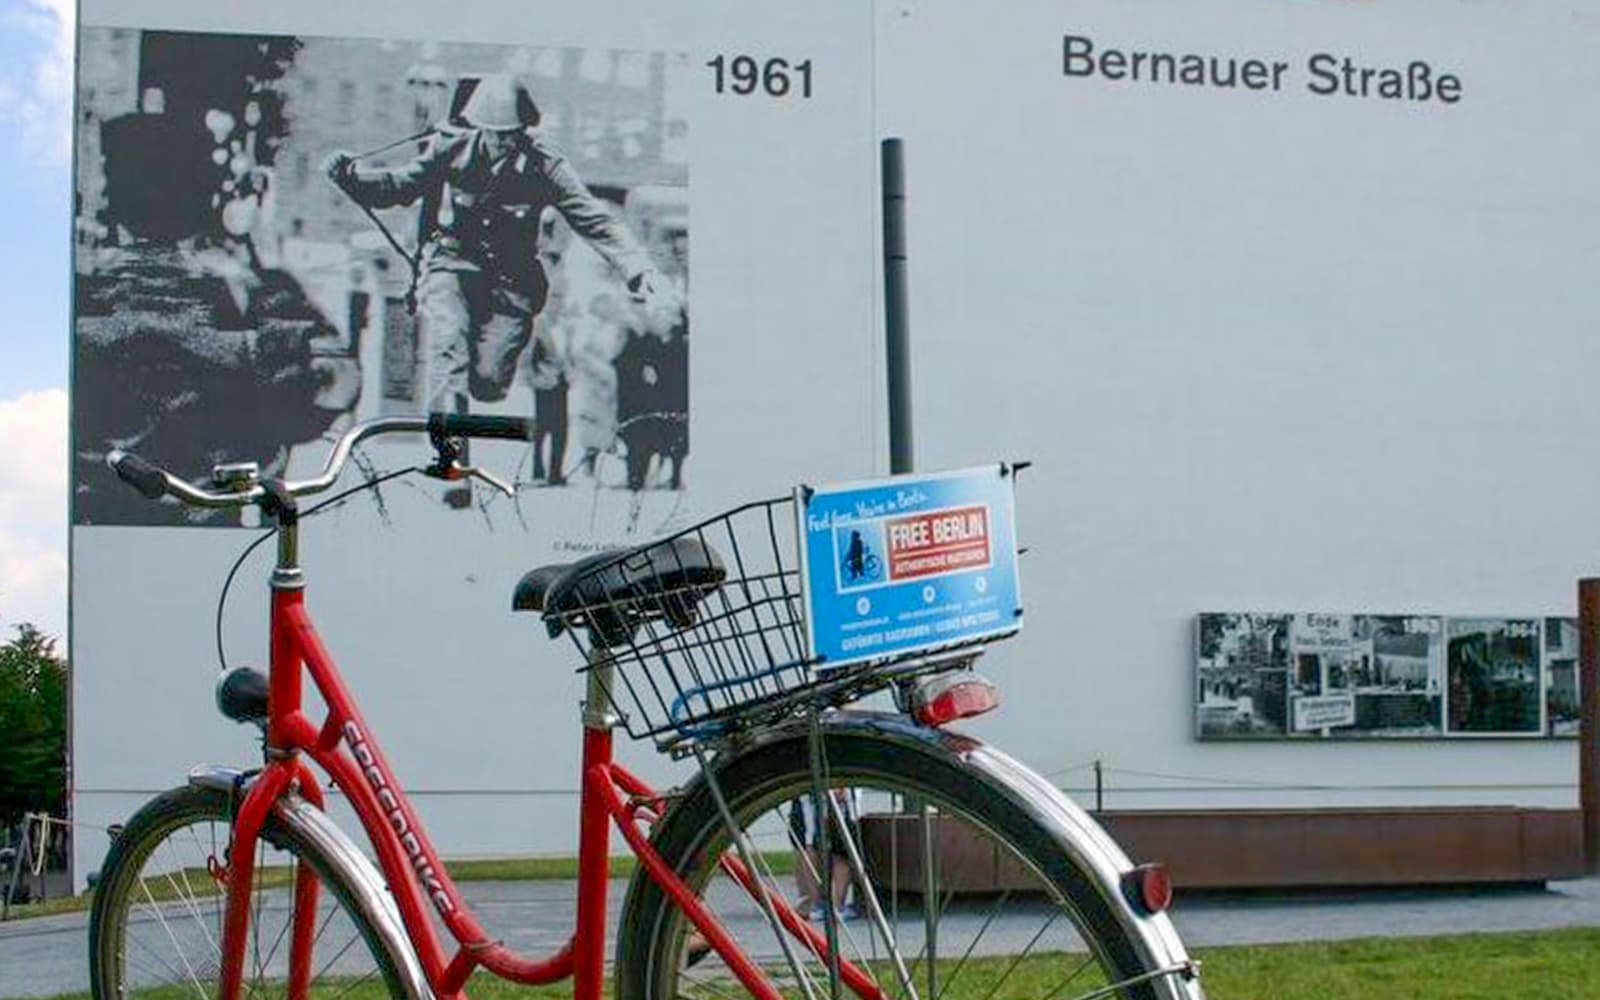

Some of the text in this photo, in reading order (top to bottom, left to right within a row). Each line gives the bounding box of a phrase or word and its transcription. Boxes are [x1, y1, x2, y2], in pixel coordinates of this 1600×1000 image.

[705, 53, 812, 98] 1961
[1062, 34, 1463, 103] Bernauer Straße
[889, 510, 985, 550] FREE BERLIN
